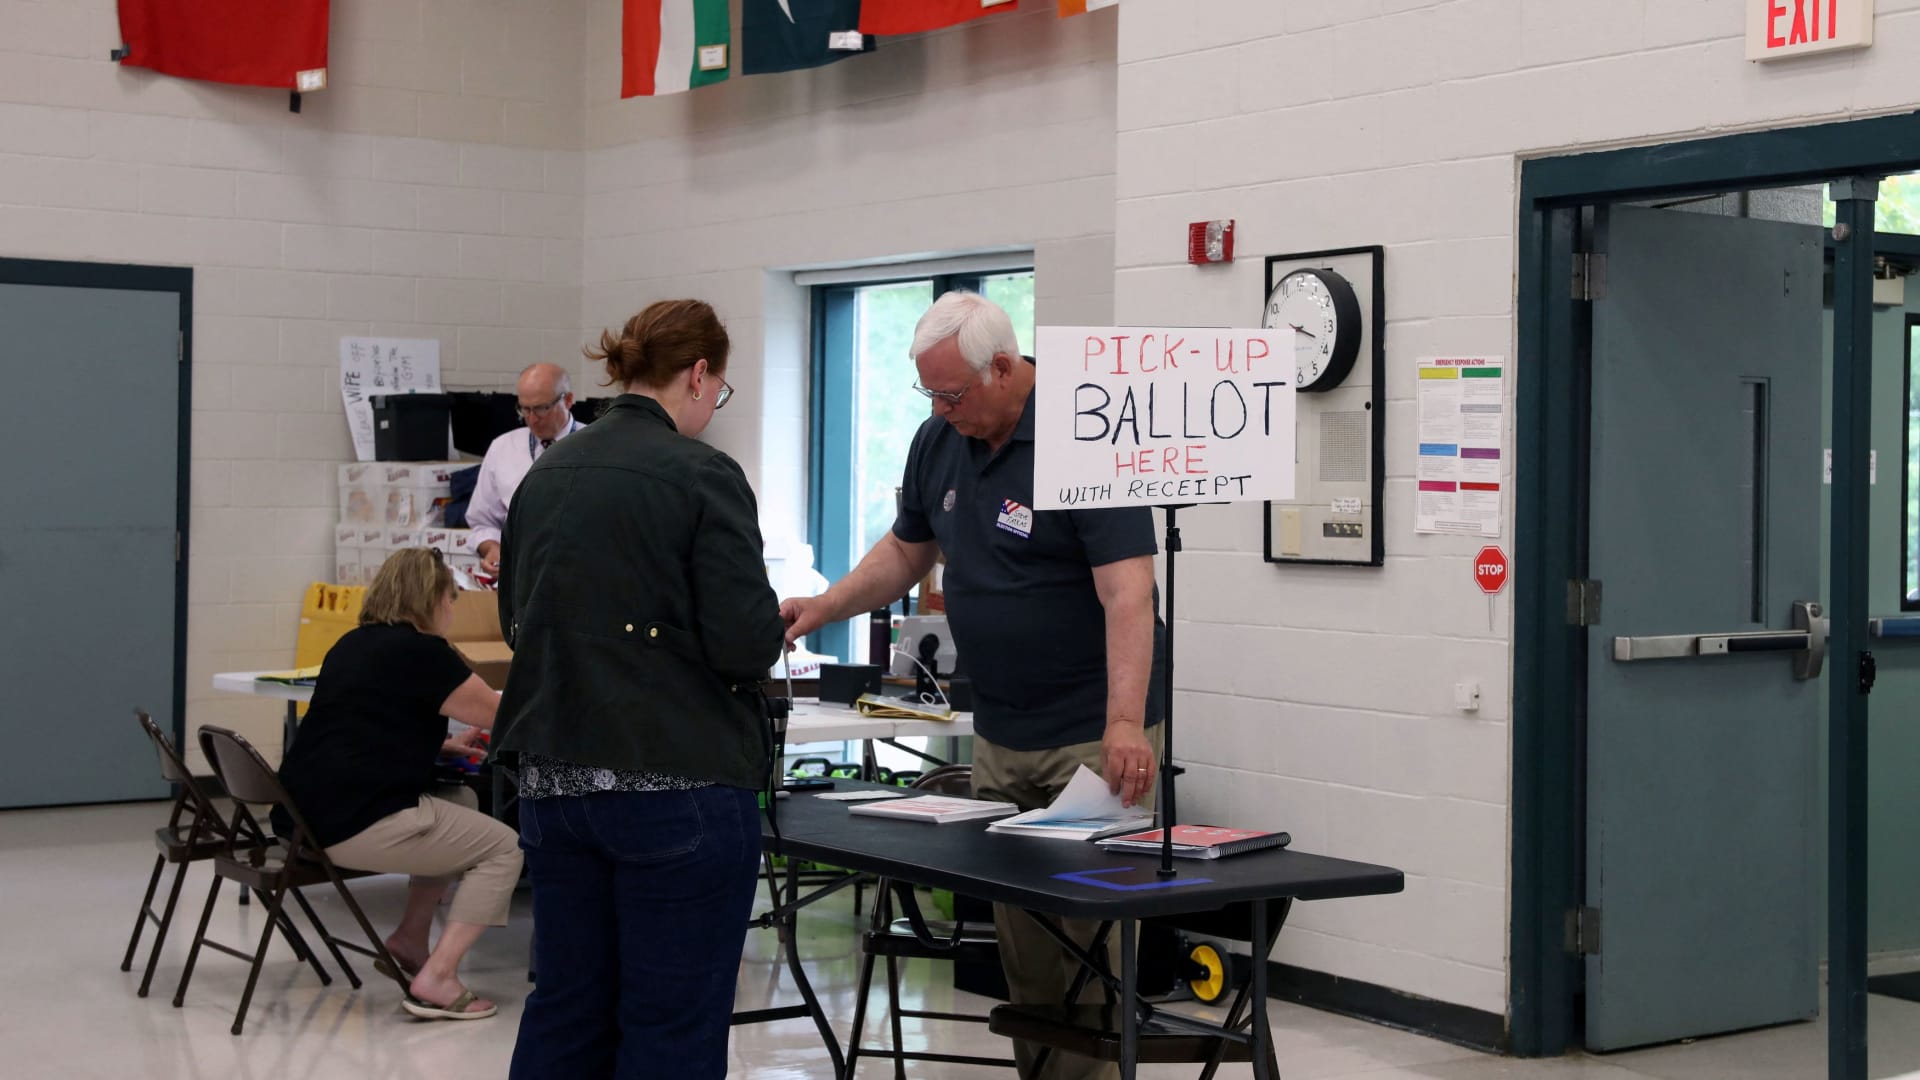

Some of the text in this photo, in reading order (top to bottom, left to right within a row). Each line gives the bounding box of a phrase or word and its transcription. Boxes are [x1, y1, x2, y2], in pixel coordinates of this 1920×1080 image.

[1296, 275, 1305, 287] 12
[1282, 283, 1289, 296] 11
[1325, 295, 1331, 308] 2
[1270, 303, 1279, 315] 10
[1327, 320, 1334, 333] 3
[1085, 334, 1270, 375] PICK-UP
[1322, 344, 1329, 356] 4
[1312, 363, 1318, 376] 5
[1297, 370, 1304, 384] 6
[1074, 379, 1287, 446] BALLOT
[1115, 445, 1209, 478] HERE
[1059, 475, 1252, 505] WITH RECEIPT
[1478, 564, 1504, 576] STOP
